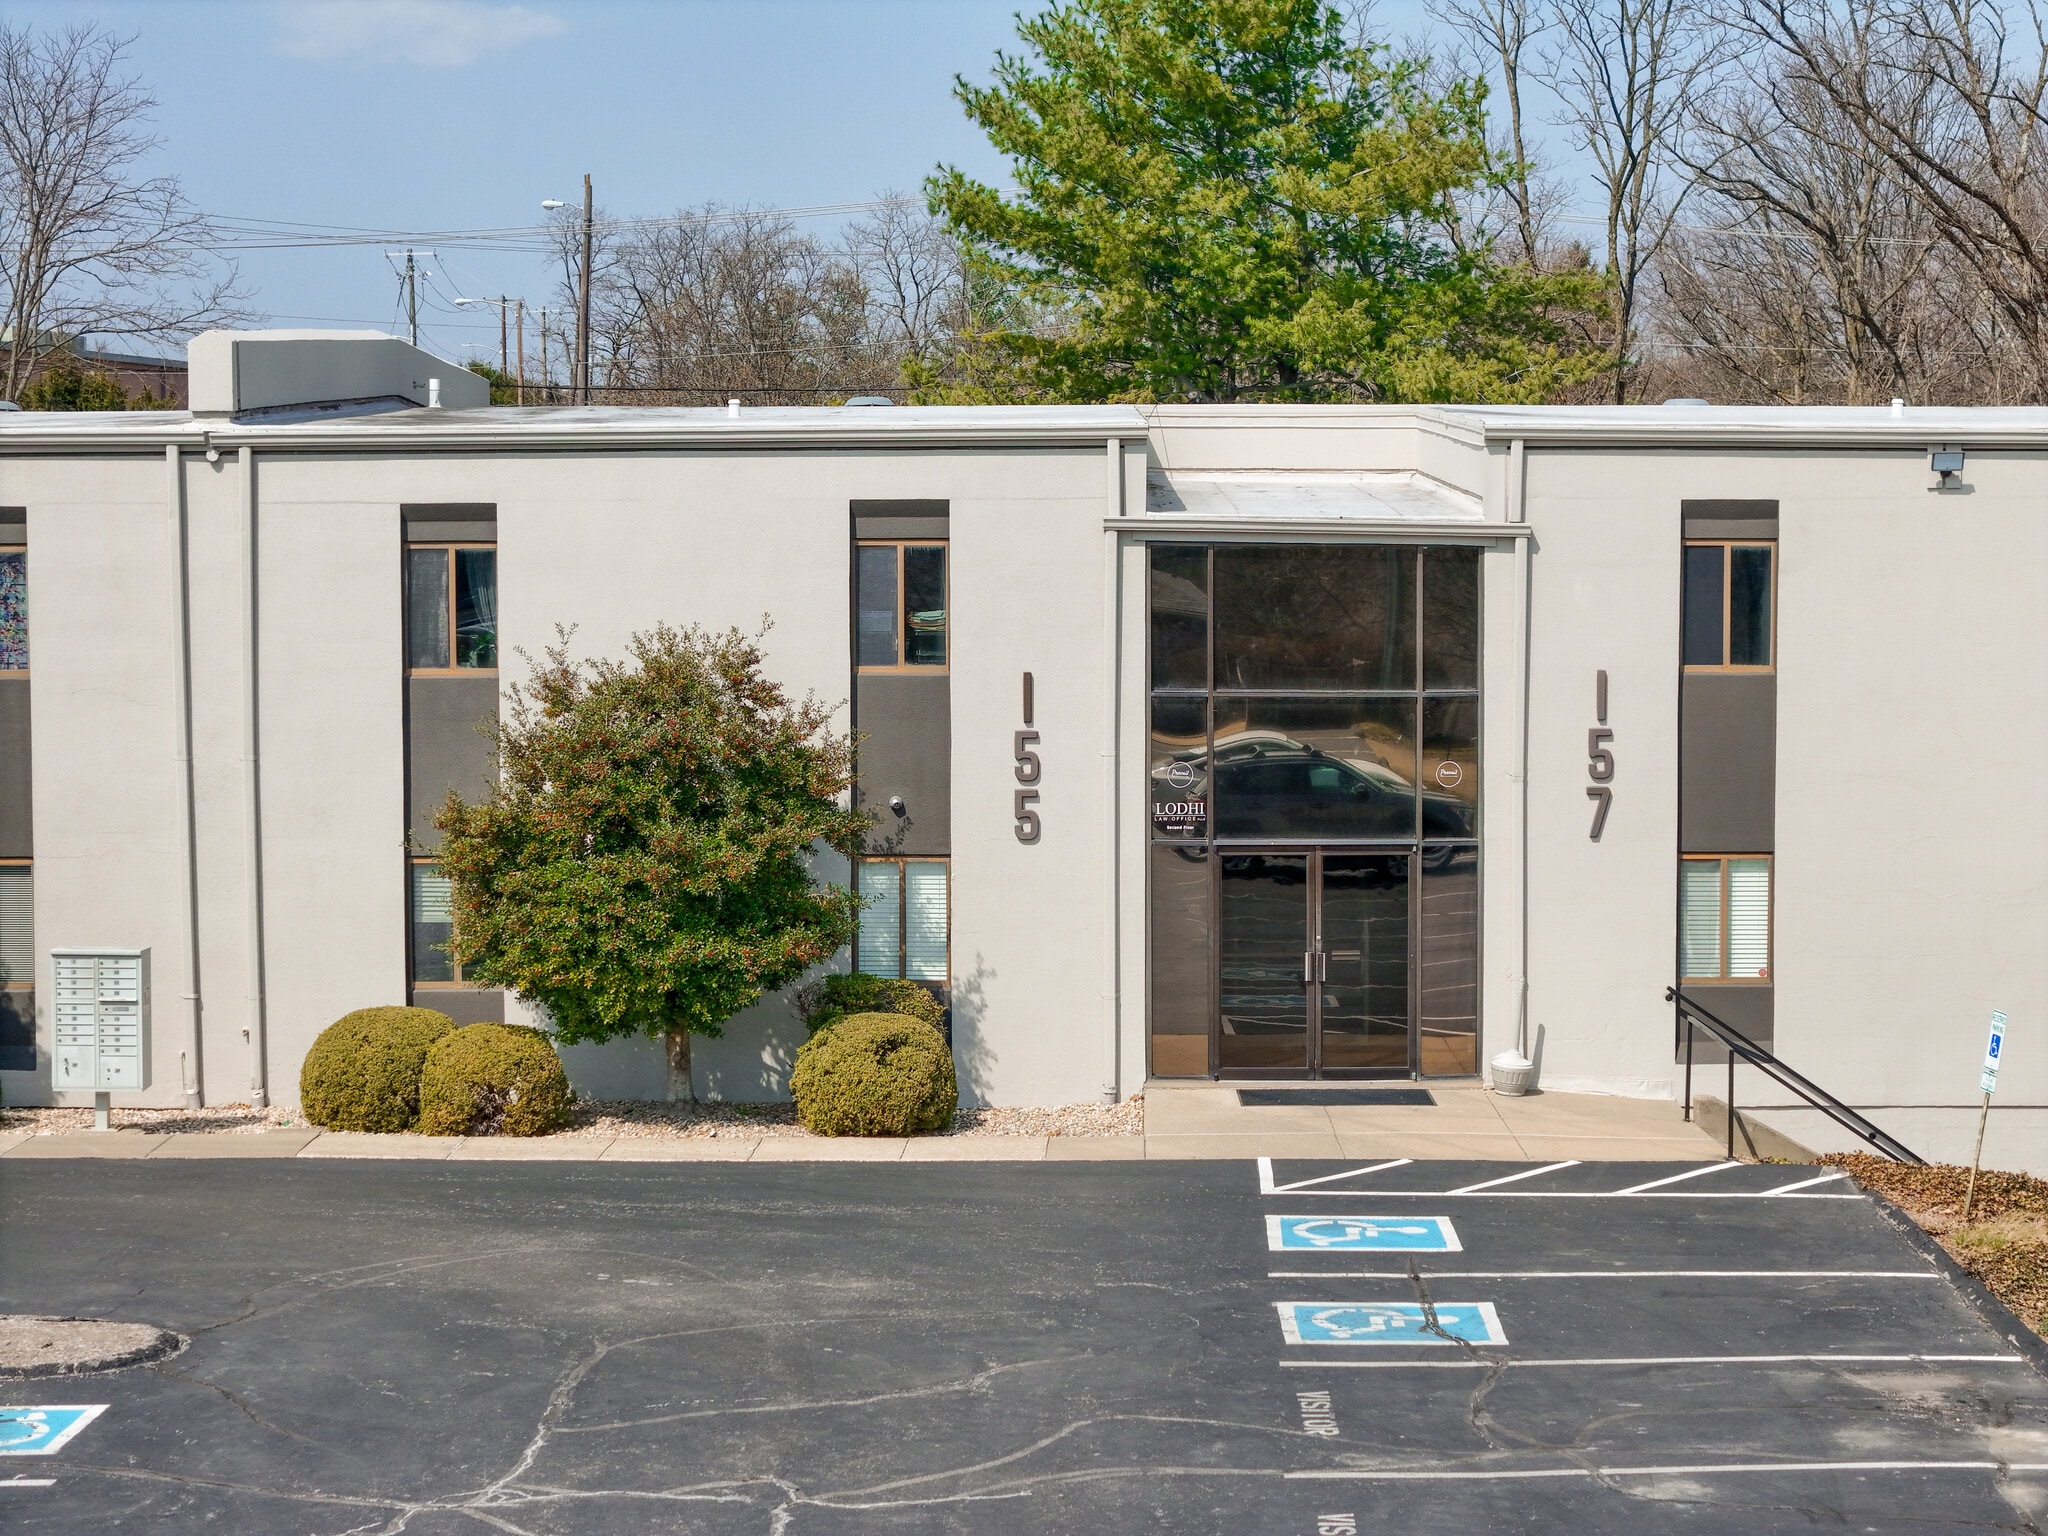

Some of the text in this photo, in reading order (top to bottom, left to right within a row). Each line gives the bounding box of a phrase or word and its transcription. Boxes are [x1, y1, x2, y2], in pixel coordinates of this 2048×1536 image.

[1015, 672, 1041, 841] 155
[1586, 669, 1613, 839] 157
[1155, 802, 1205, 815] LODHI
[1296, 1391, 1340, 1436] VISITOR
